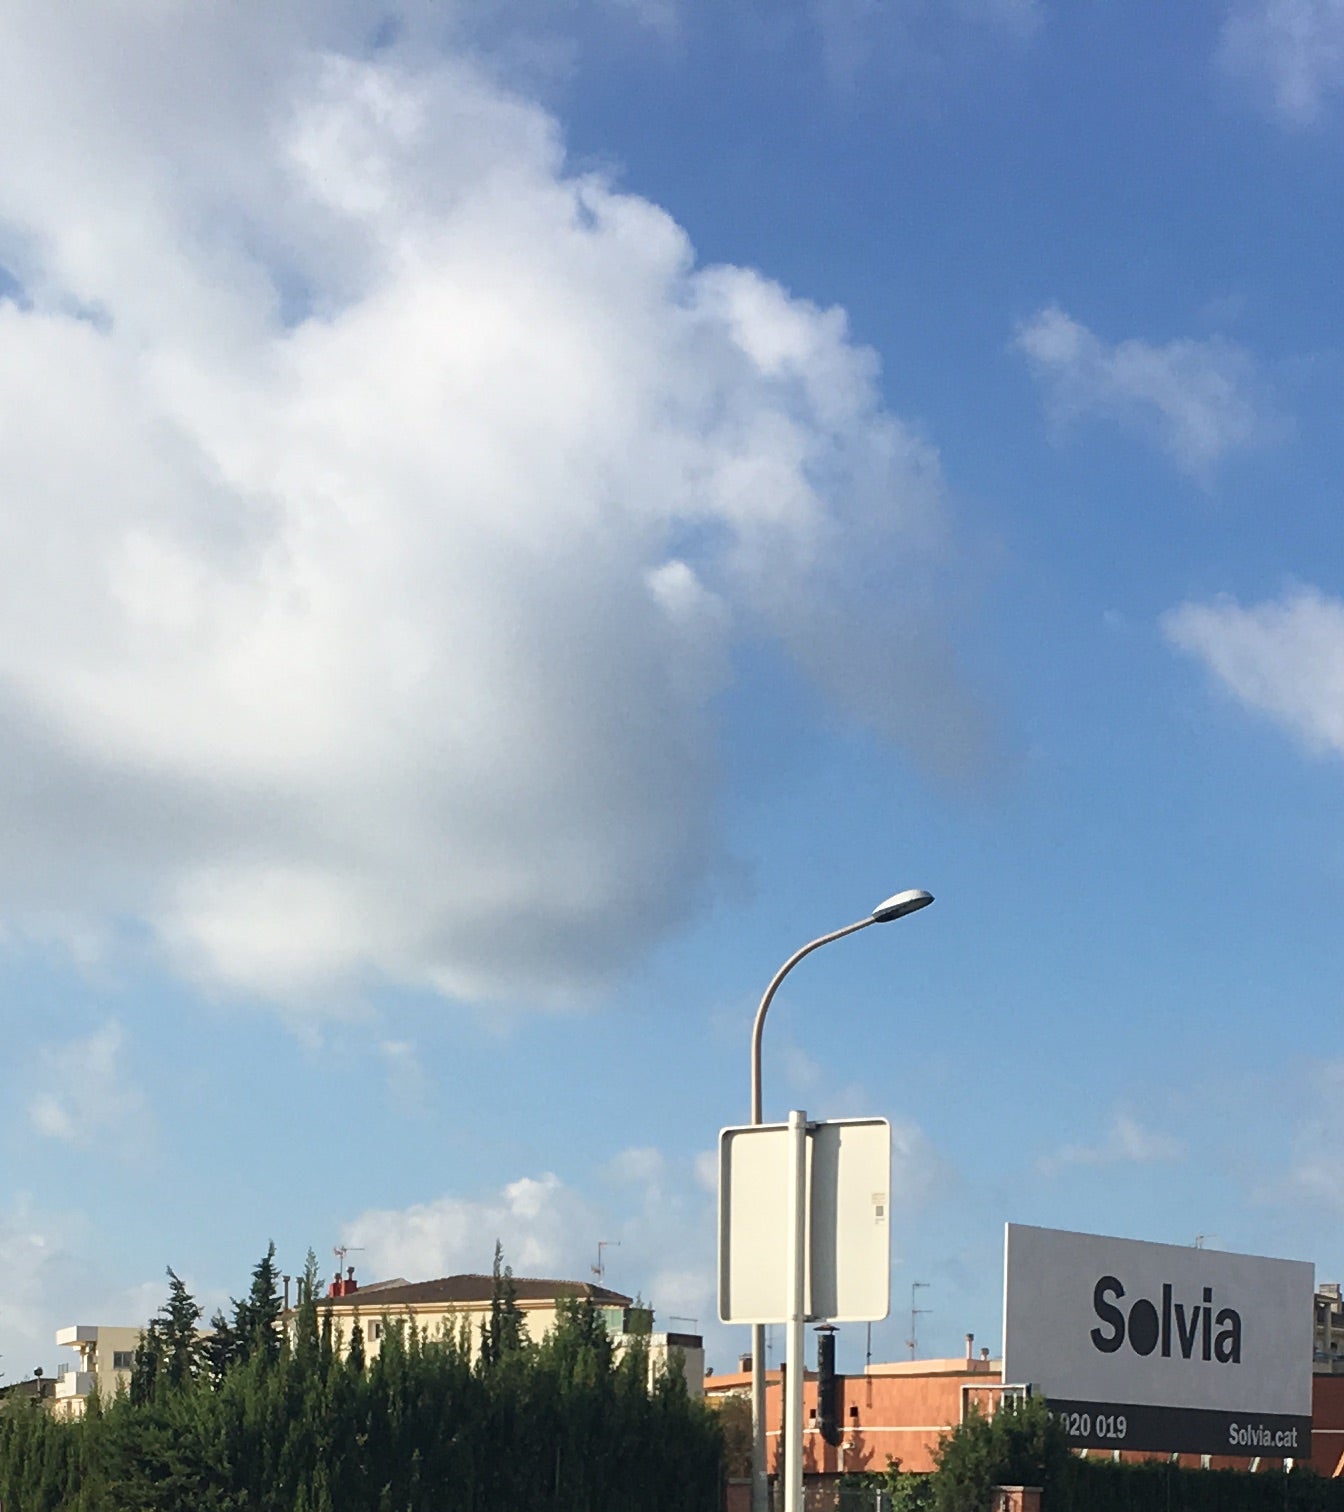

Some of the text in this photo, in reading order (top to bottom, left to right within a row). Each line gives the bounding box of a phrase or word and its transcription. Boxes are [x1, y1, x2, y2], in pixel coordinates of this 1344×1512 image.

[1090, 1275, 1242, 1364] Solvia
[1096, 1414, 1127, 1439] 019
[1228, 1423, 1298, 1448] Solvia.cat
